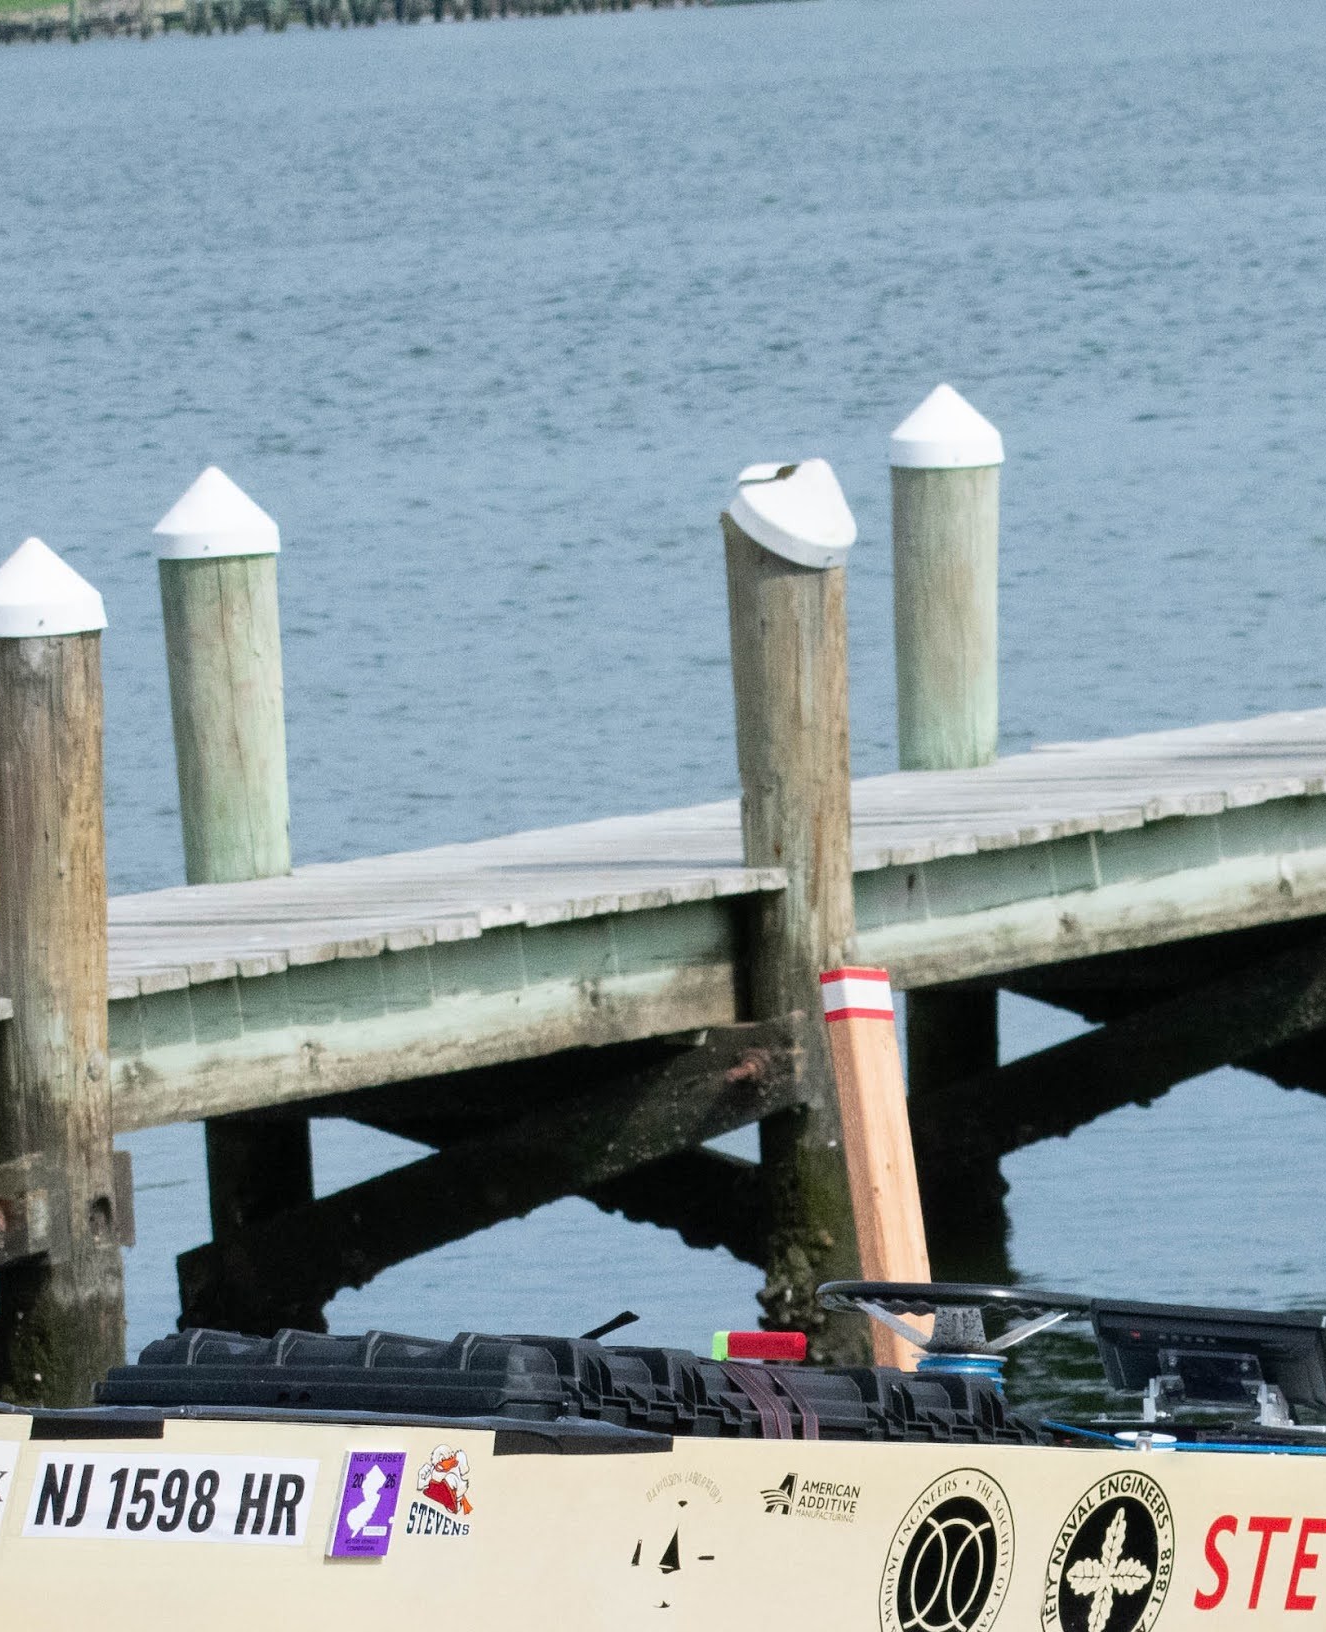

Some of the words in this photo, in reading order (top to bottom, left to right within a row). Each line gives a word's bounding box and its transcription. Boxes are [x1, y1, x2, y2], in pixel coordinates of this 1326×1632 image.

[352, 1453, 373, 1462] NEW
[373, 1454, 403, 1462] JERSEY
[352, 1473, 364, 1488] 20
[385, 1474, 397, 1489] 26
[801, 1480, 861, 1499] AMERICAN
[976, 1479, 994, 1501] THE
[34, 1463, 95, 1527] NJ
[106, 1467, 220, 1533] 1598
[233, 1472, 305, 1536] HR
[798, 1495, 857, 1514] ADDITIVE
[898, 1477, 959, 1547] ENGINEERS
[406, 1501, 471, 1536] STEVENS
[795, 1509, 855, 1523] MANUFACTURING
[1051, 1496, 1097, 1566] NAVAL
[1099, 1475, 1170, 1530] ENGINEERS
[993, 1499, 1010, 1569] SOCIETY
[884, 1556, 900, 1623] MARINE
[994, 1577, 1005, 1597] OF
[1152, 1548, 1172, 1604] 1888
